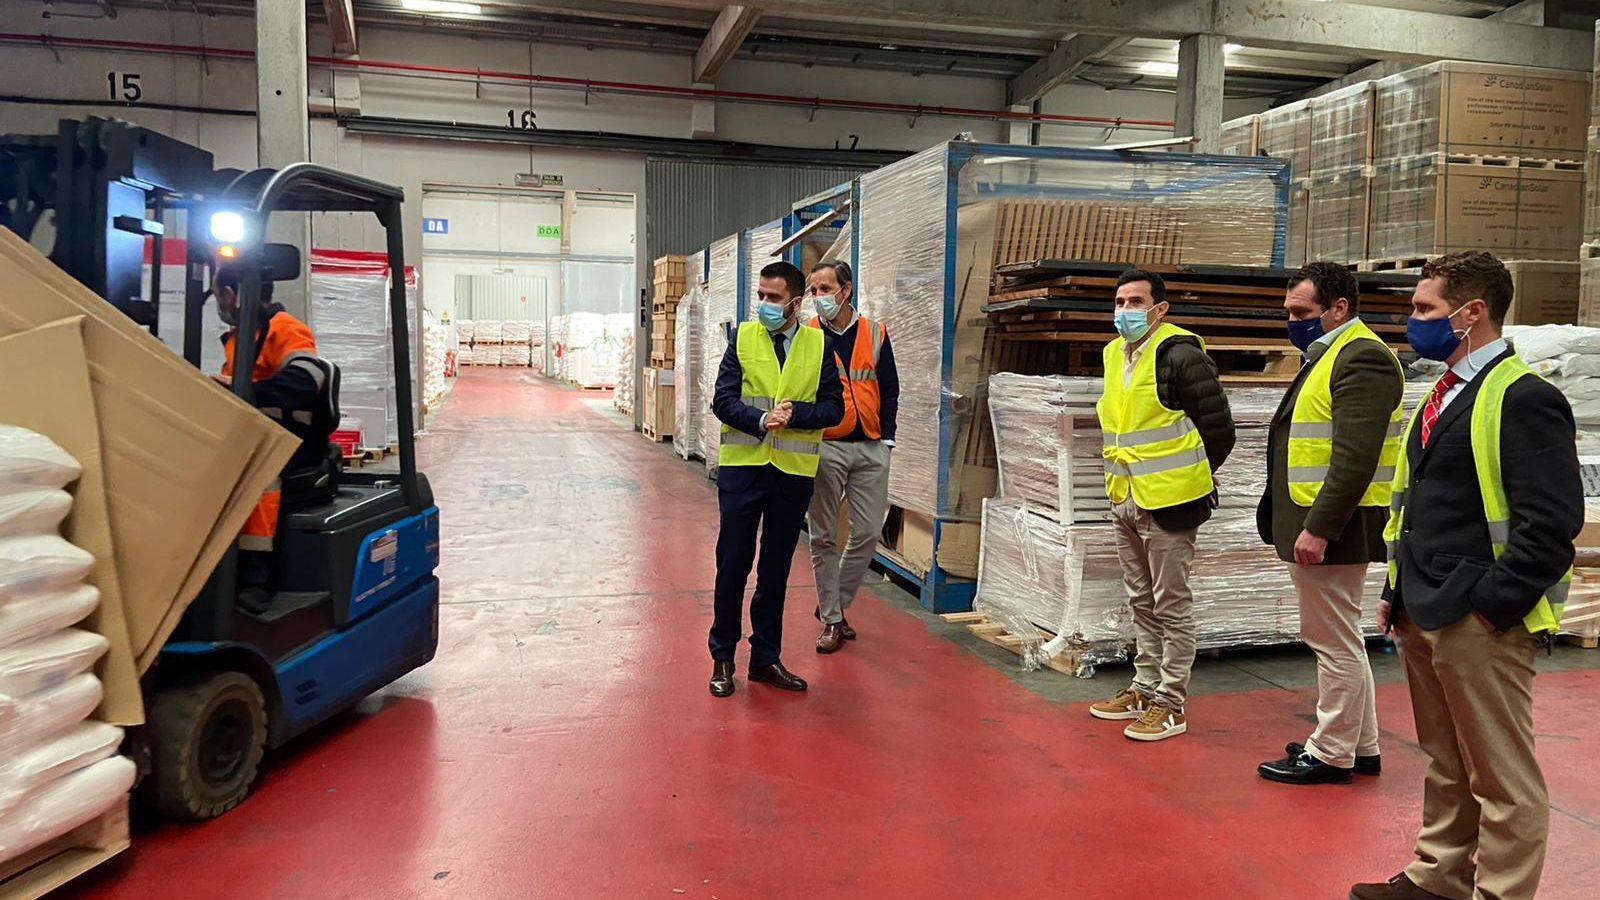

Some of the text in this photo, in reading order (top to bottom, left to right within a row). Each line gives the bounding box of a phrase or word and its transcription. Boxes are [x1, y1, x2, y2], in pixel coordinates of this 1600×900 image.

[108, 72, 141, 102] 15
[1499, 79, 1553, 92] CanadanSolar
[508, 109, 537, 130] 16
[1494, 181, 1549, 193] CanadanSolar
[428, 220, 443, 232] DA
[538, 227, 560, 236] DDA
